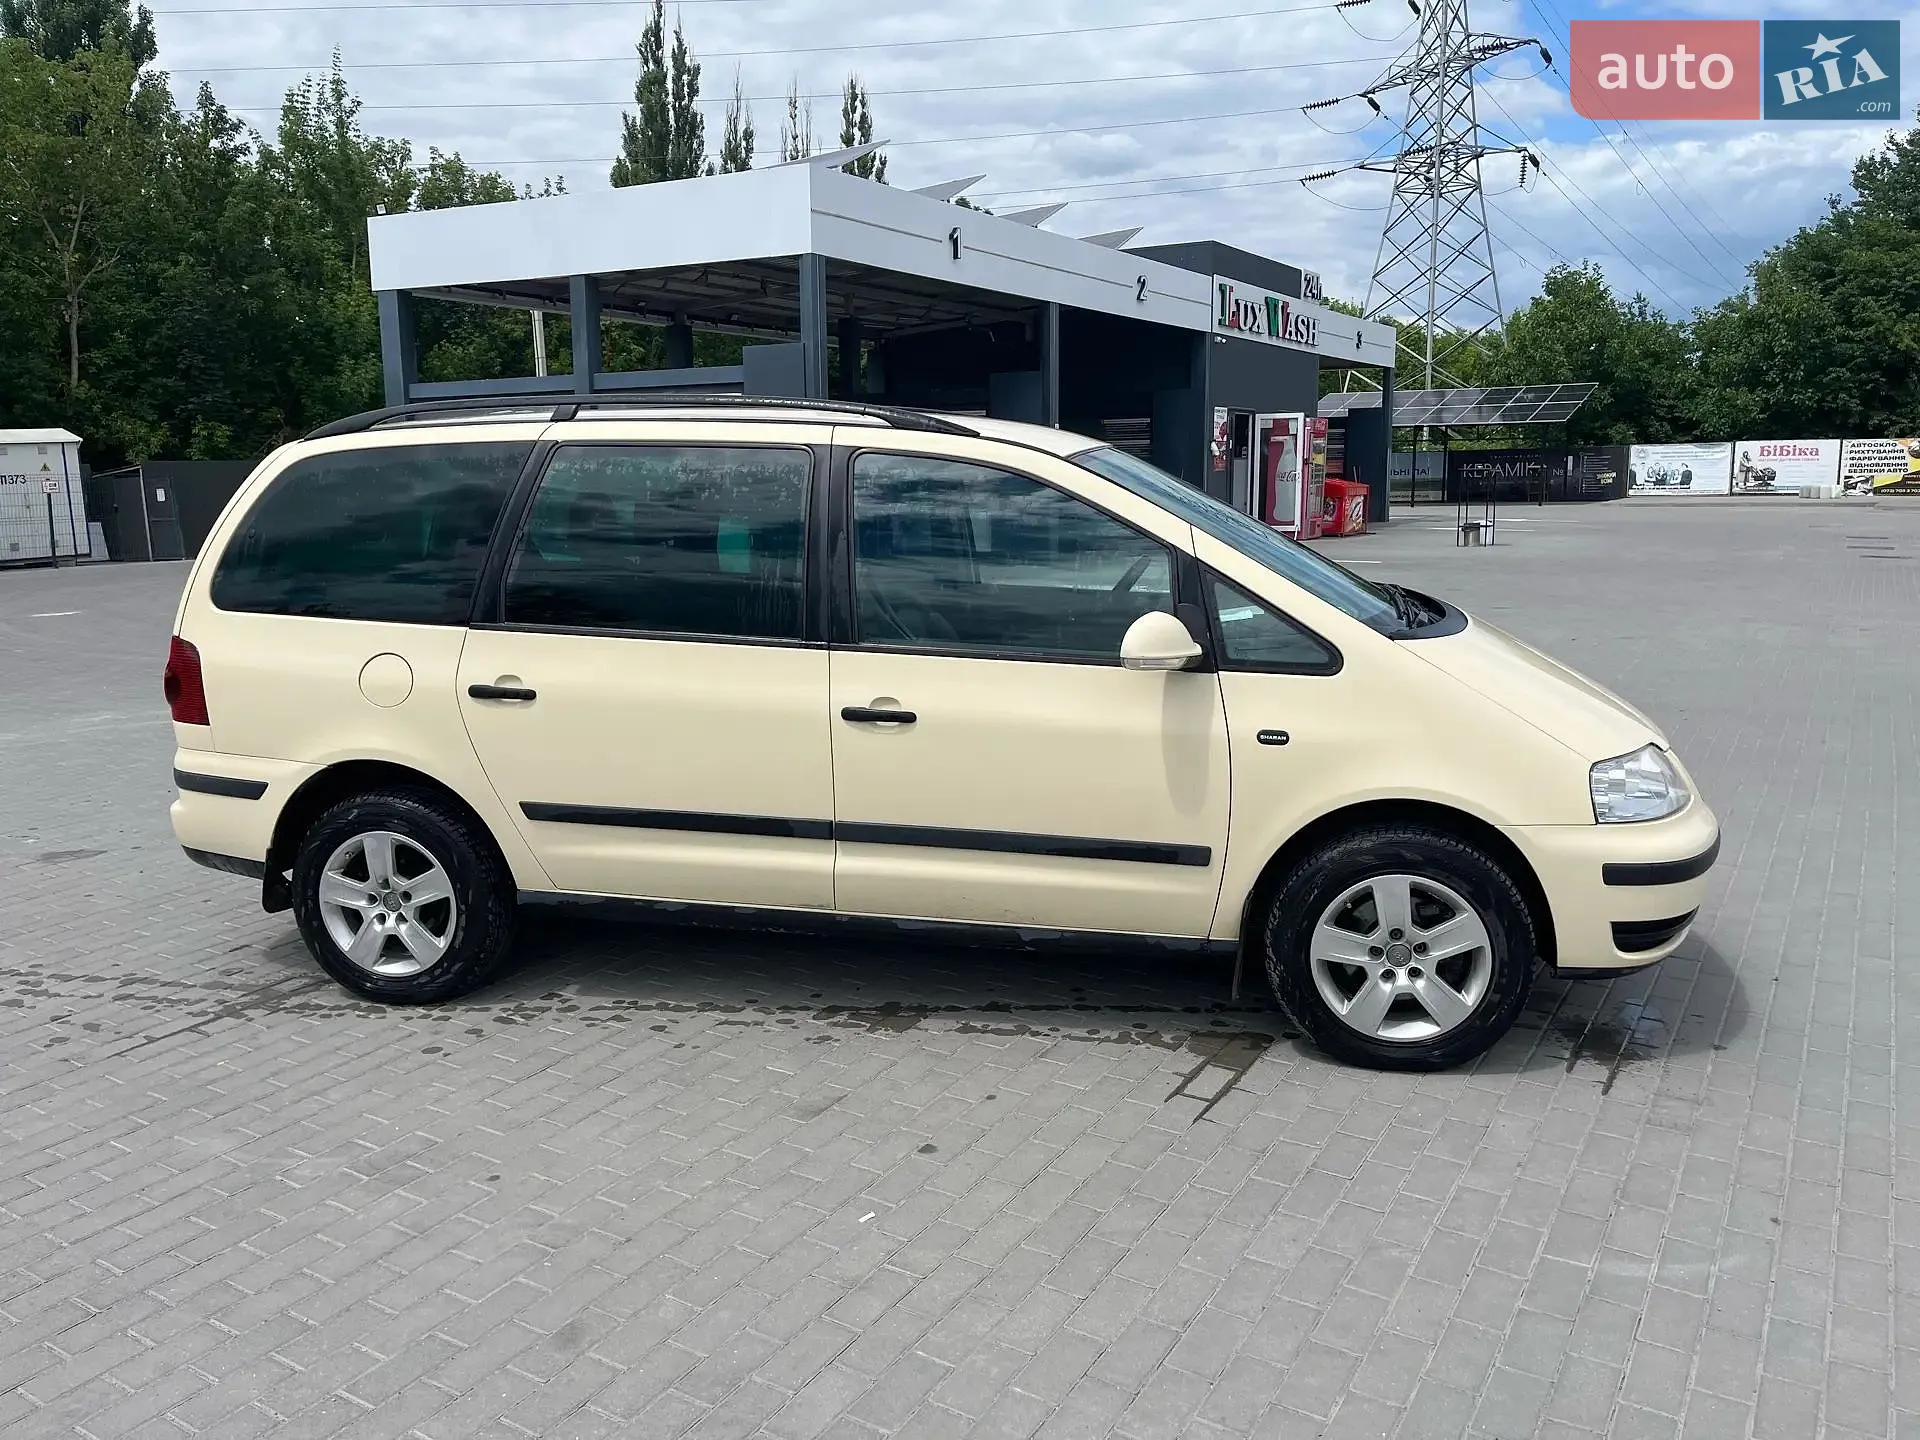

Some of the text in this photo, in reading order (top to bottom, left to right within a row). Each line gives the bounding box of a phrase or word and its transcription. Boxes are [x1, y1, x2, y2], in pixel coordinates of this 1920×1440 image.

[948, 226, 962, 260] 1
[1136, 274, 1148, 301] 2
[1759, 444, 1820, 457] БіБіка
